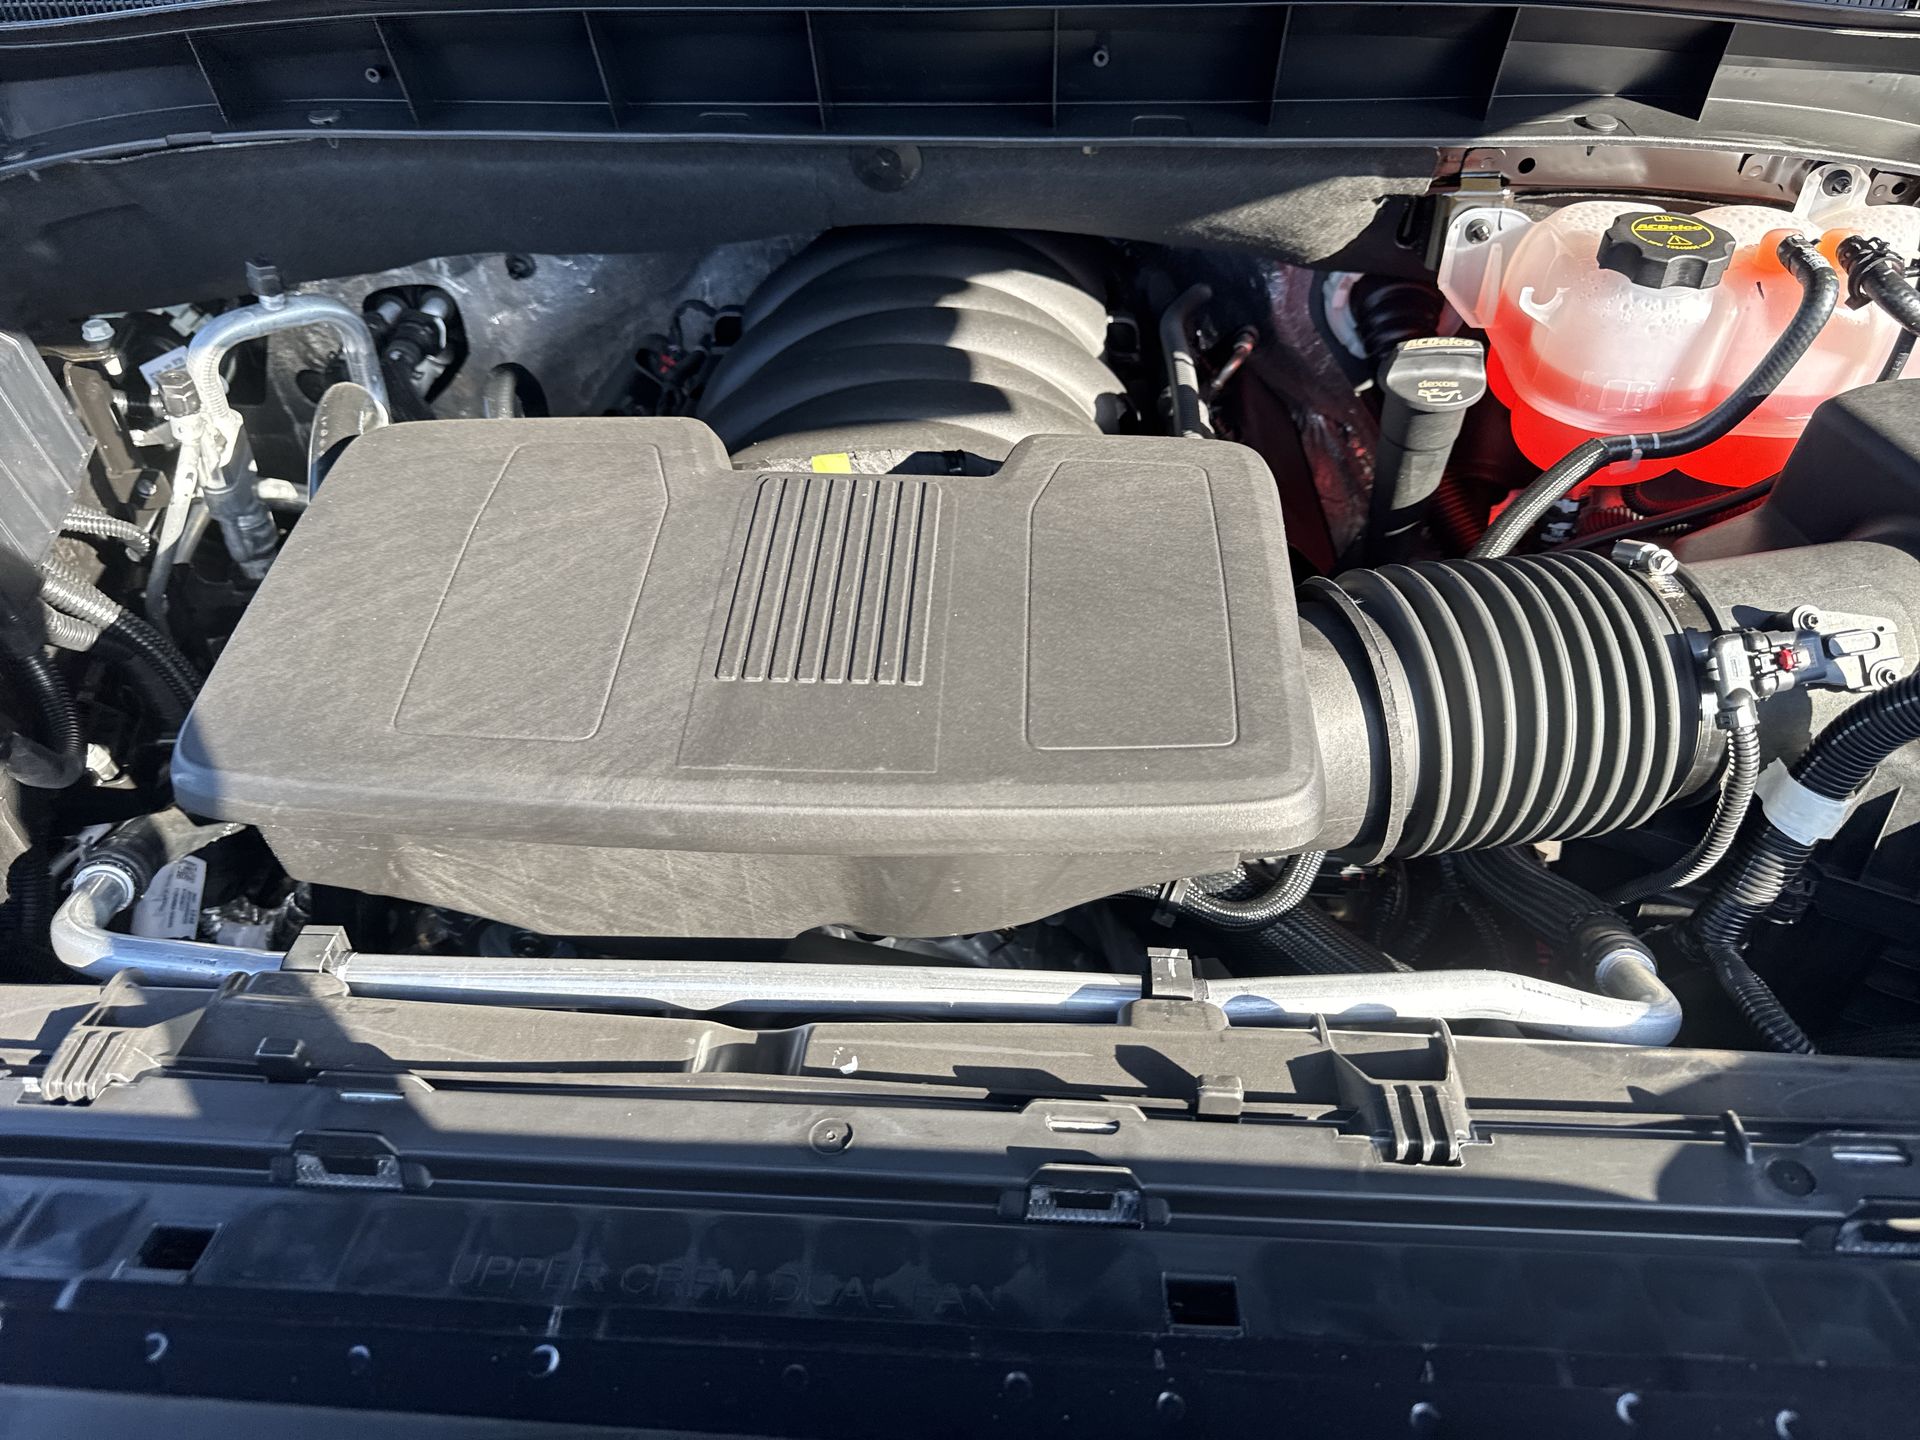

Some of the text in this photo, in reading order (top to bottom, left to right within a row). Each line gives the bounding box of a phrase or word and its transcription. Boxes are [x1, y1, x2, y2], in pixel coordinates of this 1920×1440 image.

[1635, 223, 1703, 232] ACDelco
[1403, 338, 1475, 350] ACDelco
[1418, 380, 1459, 388] dexos
[449, 1251, 607, 1292] UPPER
